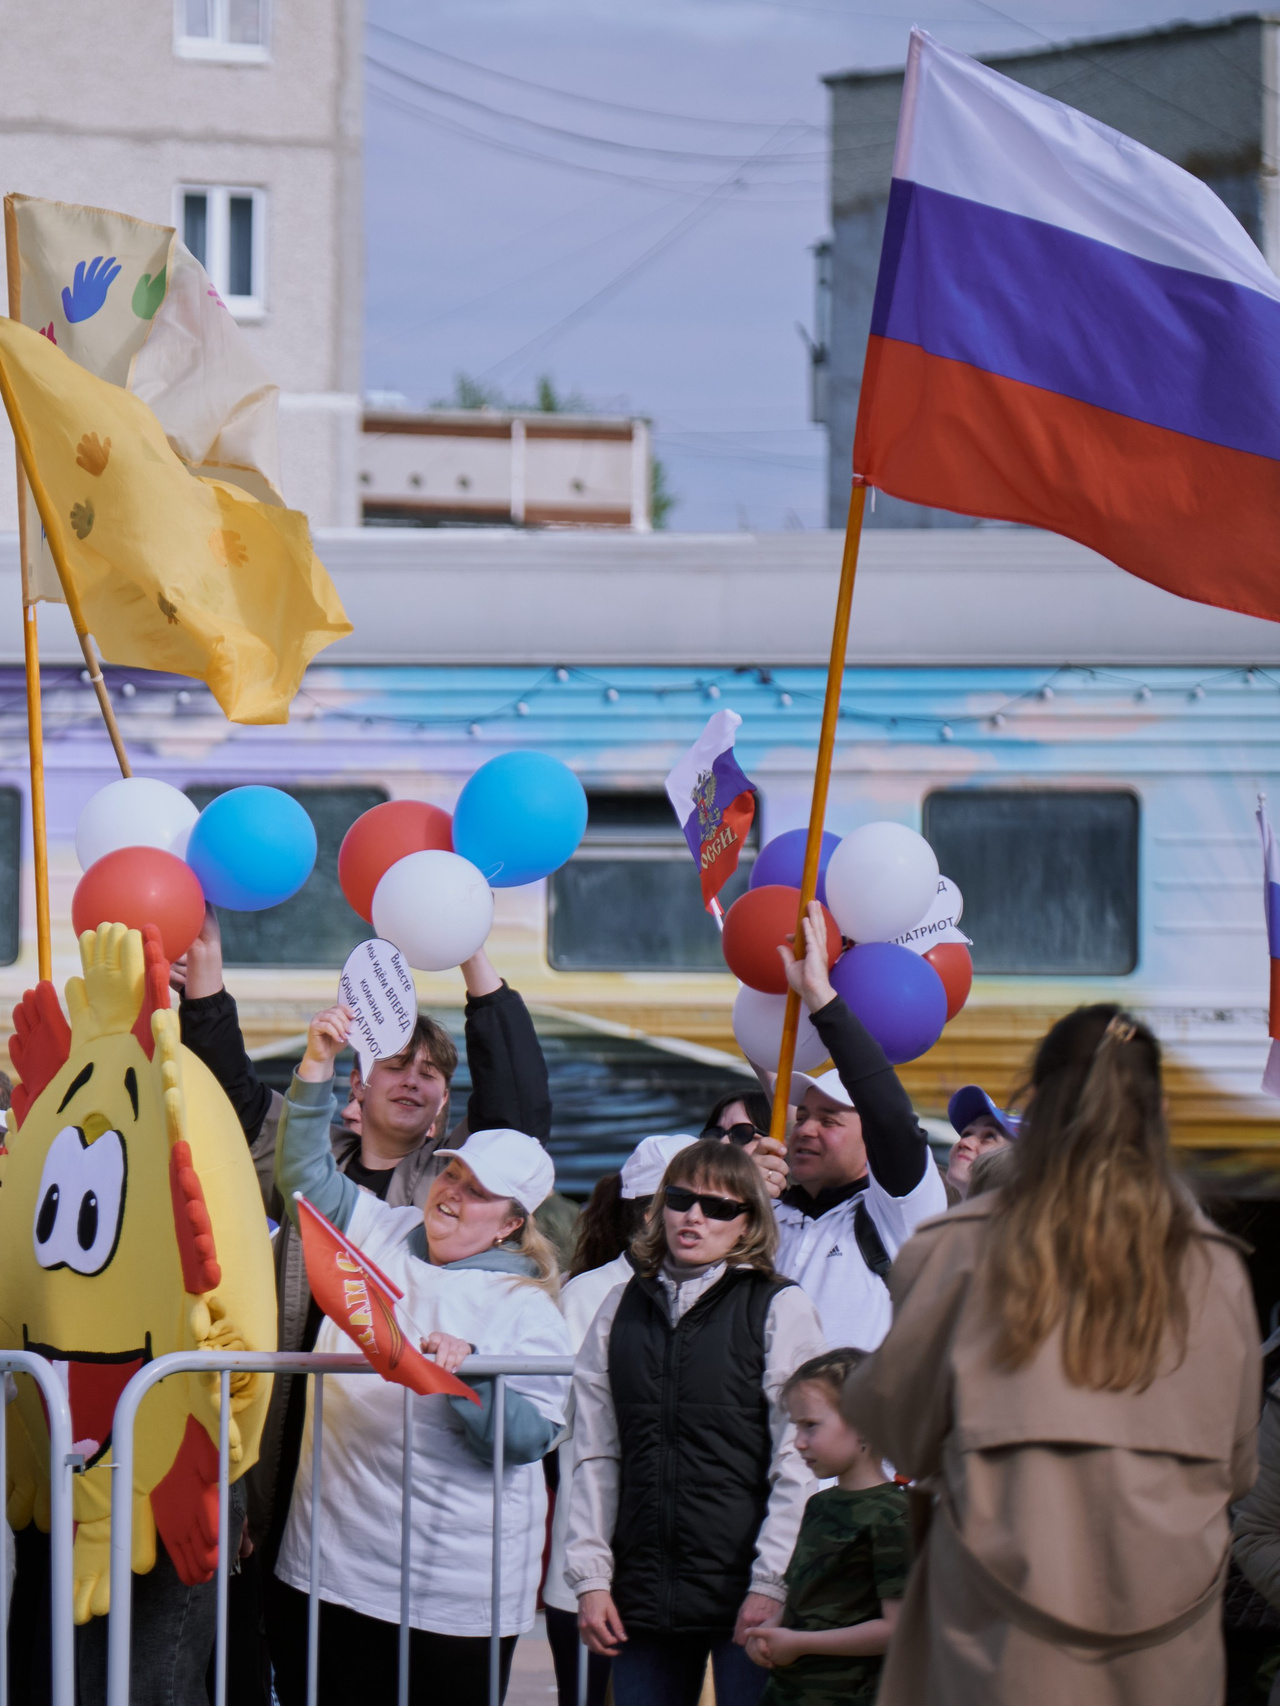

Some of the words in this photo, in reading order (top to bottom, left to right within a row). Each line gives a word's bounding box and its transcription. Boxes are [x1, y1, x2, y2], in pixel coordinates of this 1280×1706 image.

[359, 978, 385, 1025] команда
[372, 960, 389, 990] идём
[385, 987, 411, 1033] ВПЕРЁД
[390, 952, 412, 993] Вместе
[340, 973, 359, 1008] ЮНЫЙ
[353, 1007, 382, 1058] ПАТРИОТ
